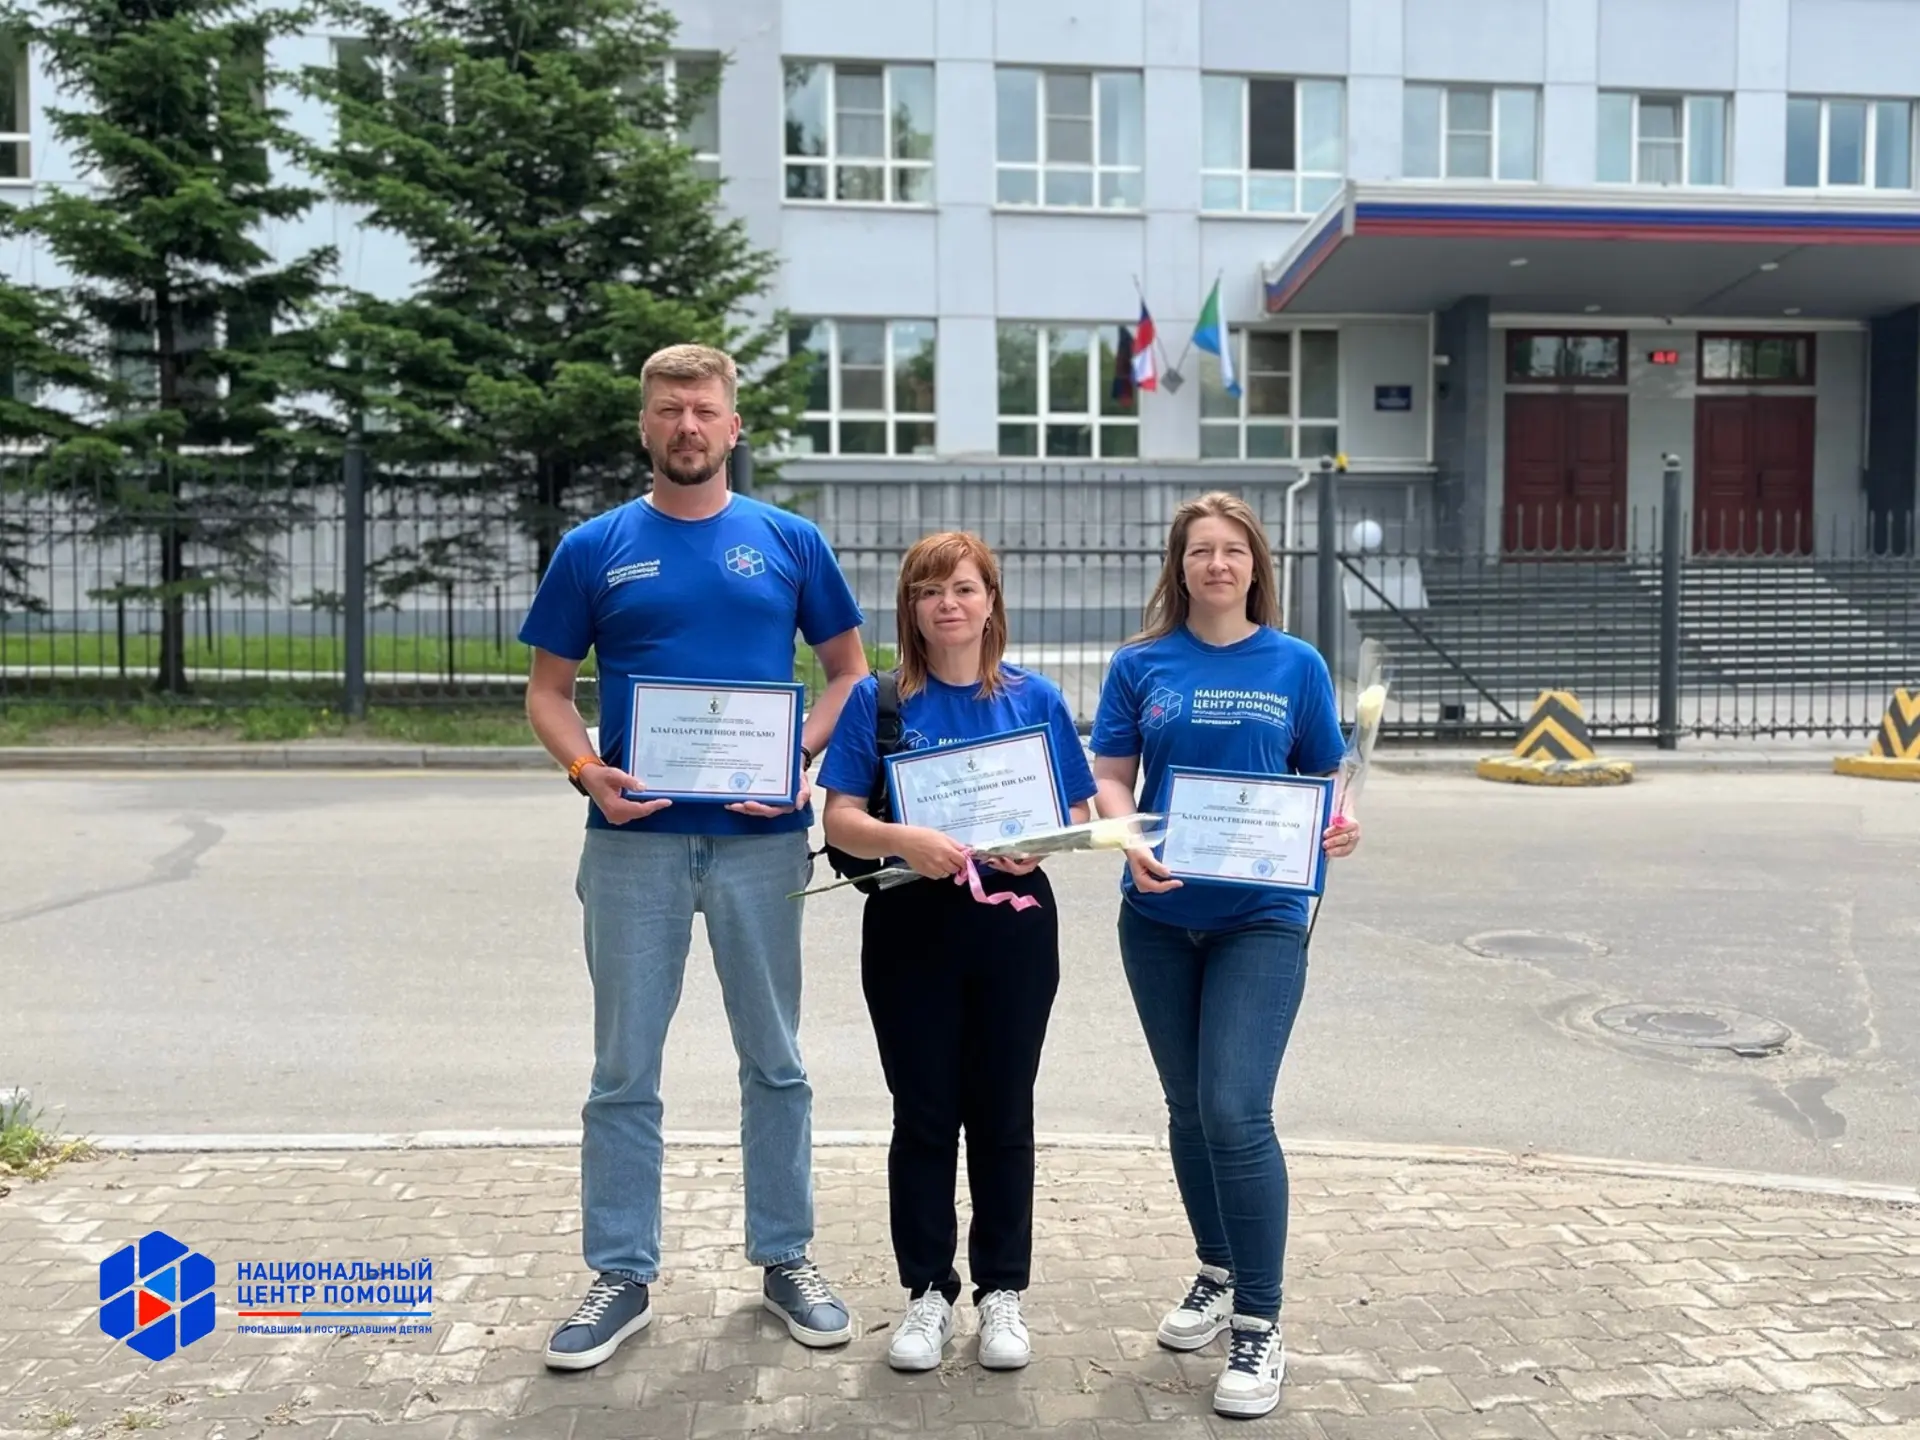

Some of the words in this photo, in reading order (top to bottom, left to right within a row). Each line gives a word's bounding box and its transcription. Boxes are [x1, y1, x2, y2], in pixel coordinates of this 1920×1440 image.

[1194, 689, 1288, 708] НАЦИОНАЛЬНЫЙ
[1193, 699, 1234, 709] ЦЕНТР
[1236, 700, 1287, 720] ПОМОЩИ
[650, 727, 737, 737] БЛАГОДАРСТВЕННОЕ
[739, 730, 775, 738] ПИСЬМО
[916, 782, 1000, 804] БЛАГОДАРСТВЕННОЕ
[1001, 775, 1036, 788] ПИСЬМО
[1182, 813, 1263, 826] БЛАГОДАРСТВЕННОЕ
[1265, 820, 1301, 829] ПИСЬМО
